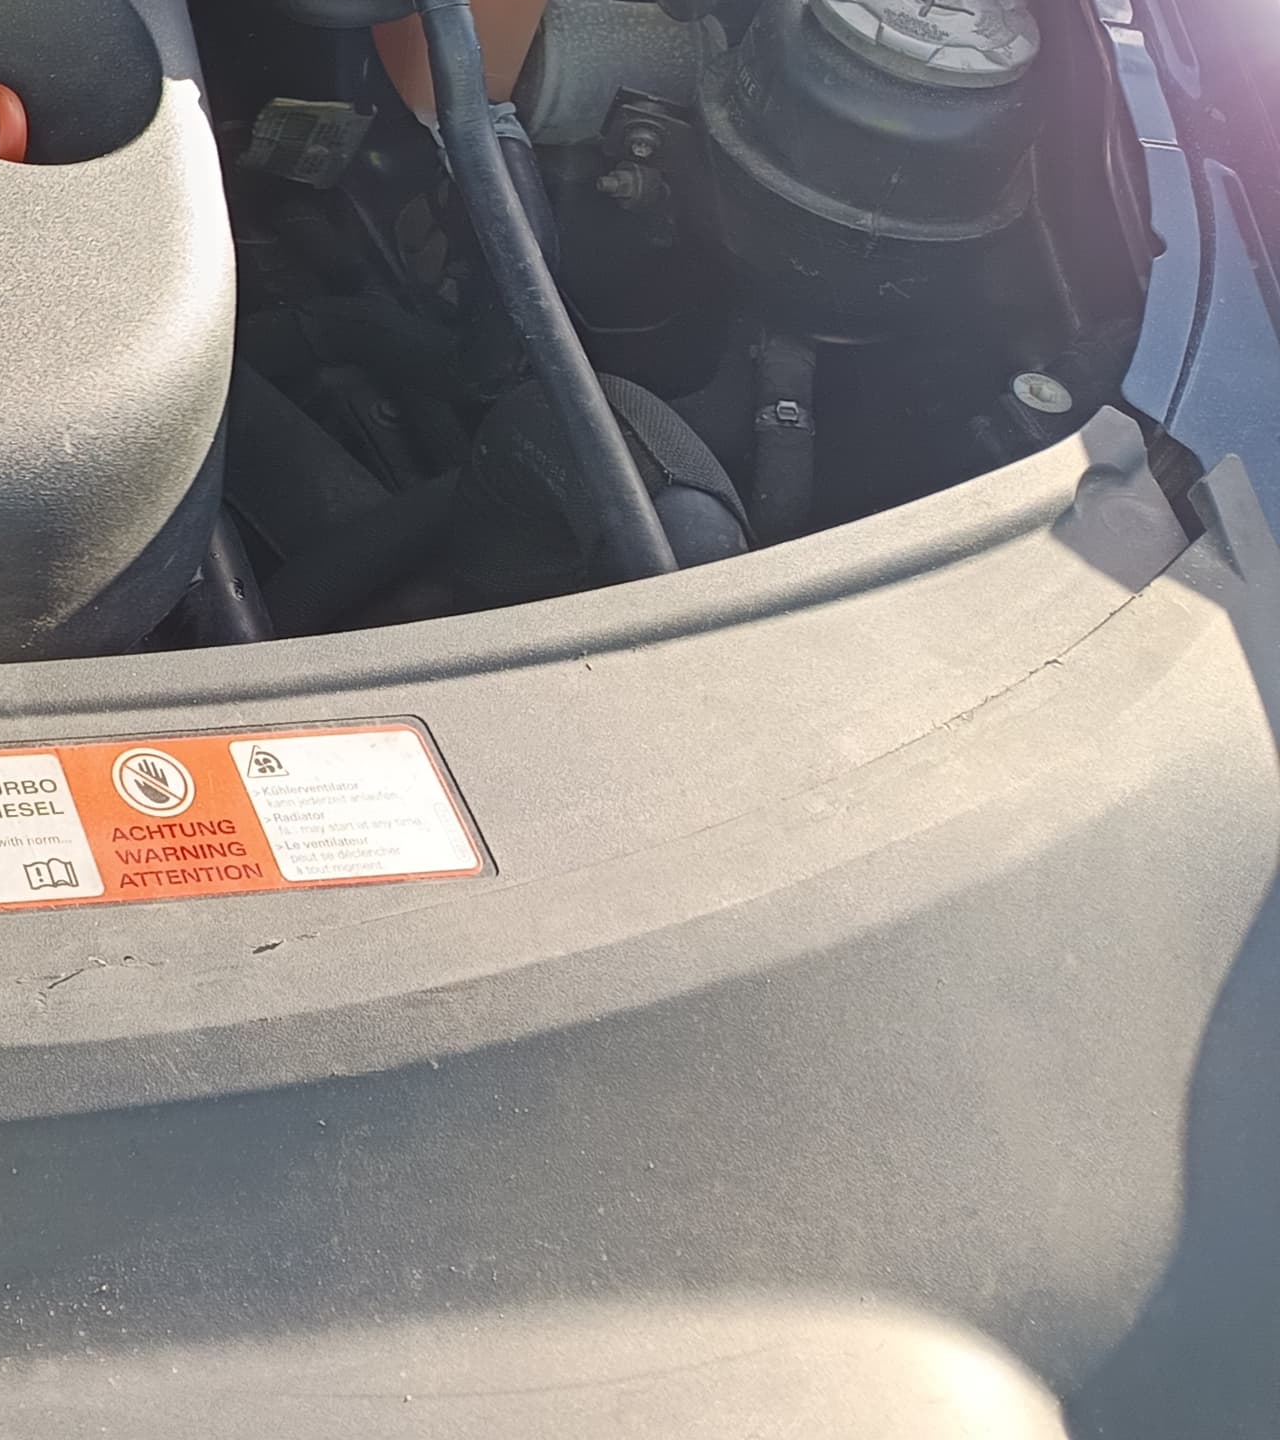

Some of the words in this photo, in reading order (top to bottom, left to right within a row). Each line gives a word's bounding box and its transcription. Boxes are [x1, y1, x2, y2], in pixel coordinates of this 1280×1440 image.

[273, 811, 326, 824] Radiator
[112, 819, 237, 843] ACHTUNG
[284, 839, 301, 851] Le
[302, 835, 370, 850] ventilateur
[115, 841, 247, 865] WARNING
[120, 863, 264, 889] ATTENTION
